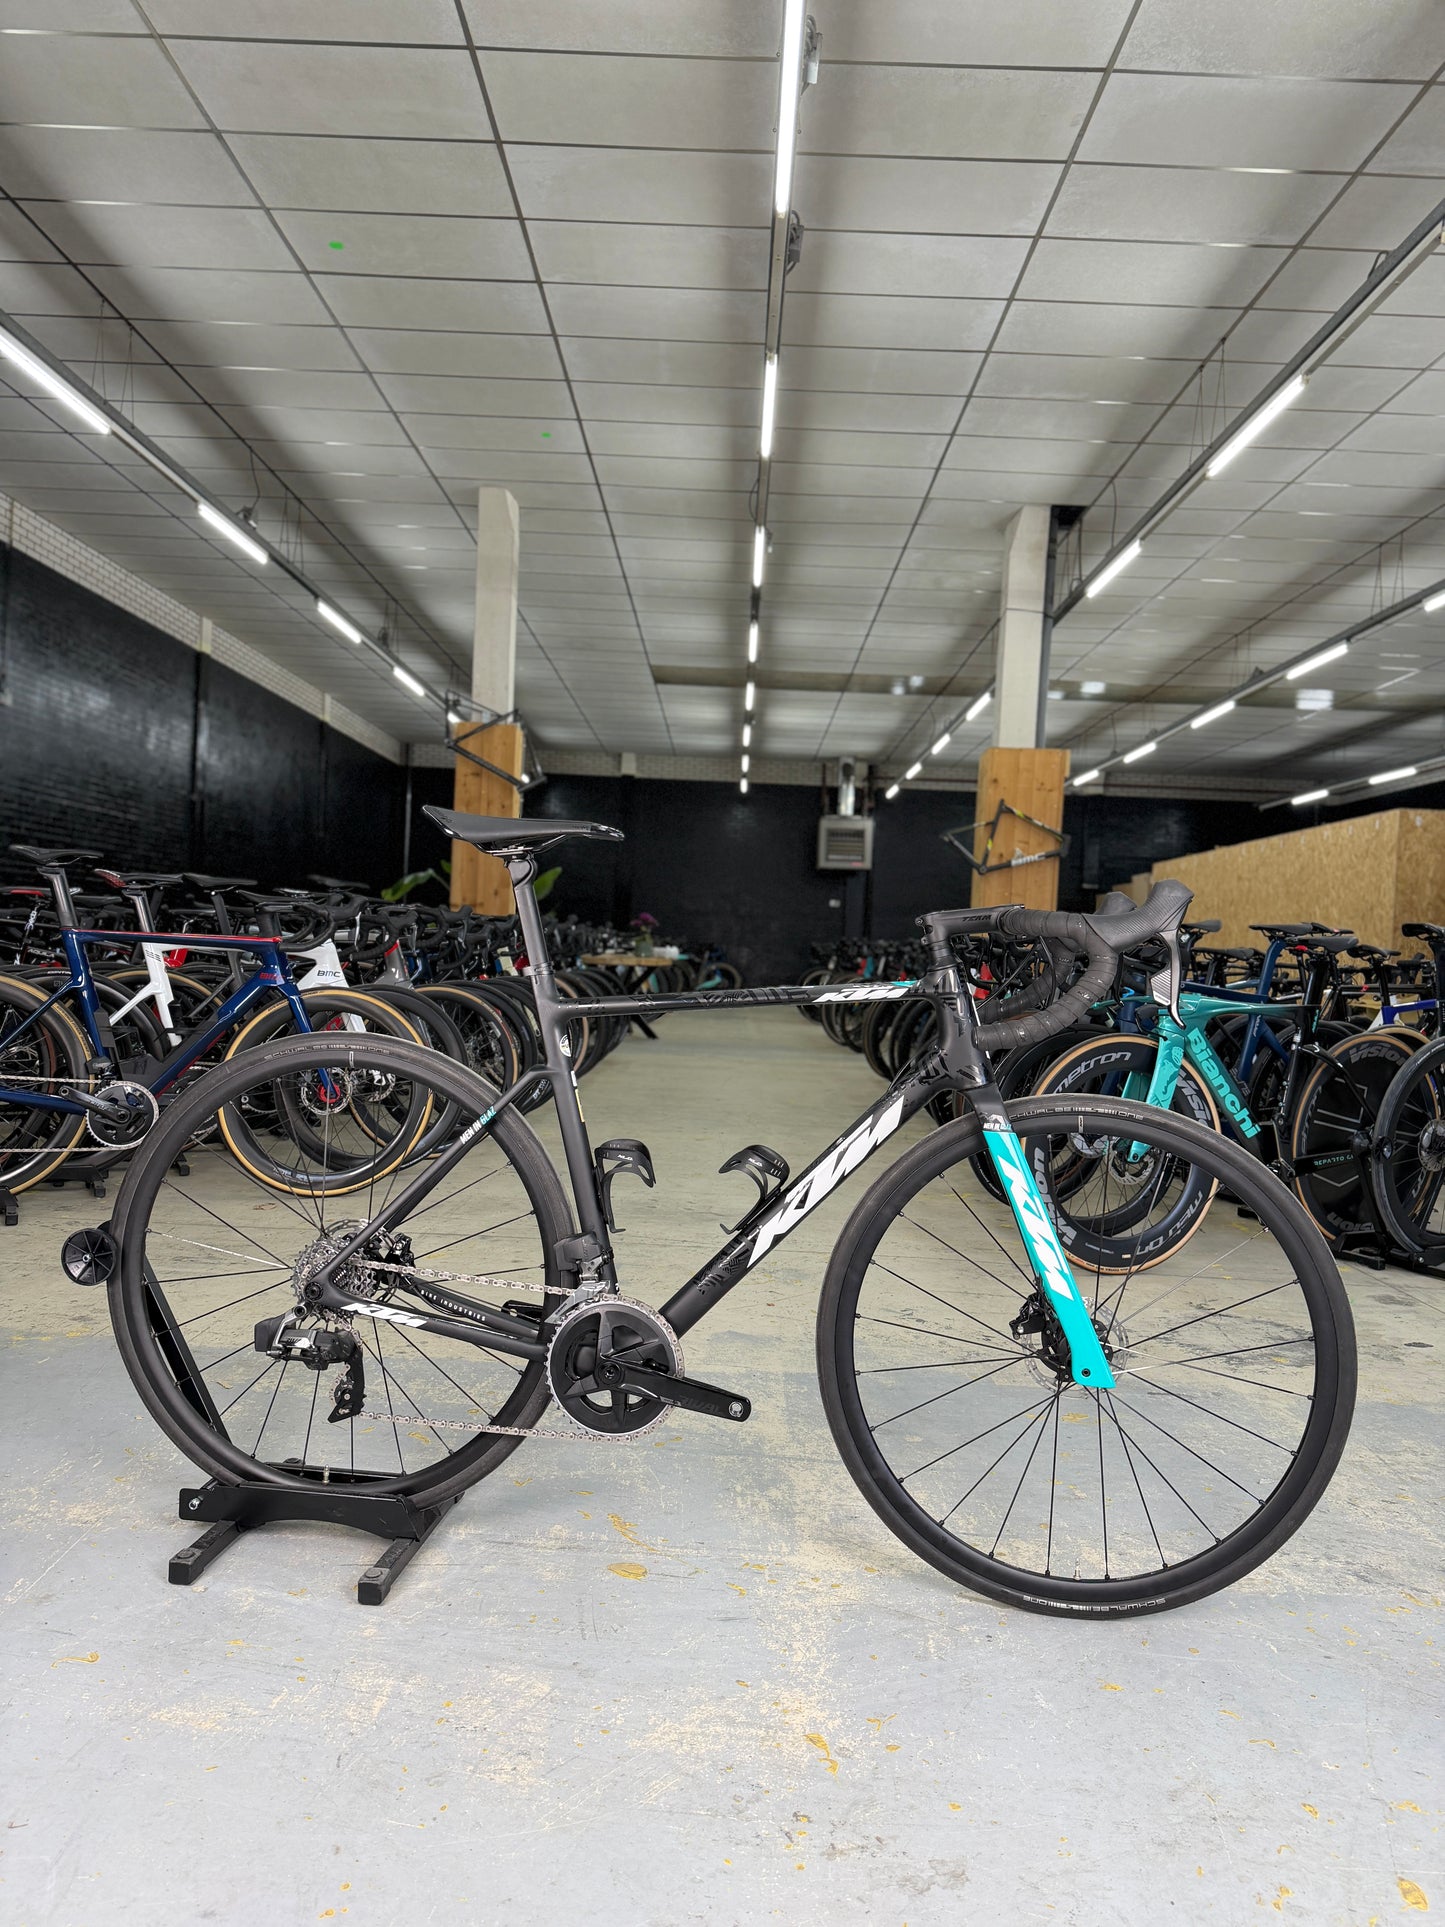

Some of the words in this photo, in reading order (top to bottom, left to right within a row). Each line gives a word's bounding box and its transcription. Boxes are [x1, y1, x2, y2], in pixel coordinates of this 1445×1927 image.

[962, 914, 992, 923] TEAM
[317, 970, 341, 978] BMC
[812, 987, 909, 1003] KTM
[1053, 1050, 1132, 1095] metron
[1187, 1027, 1261, 1139] Bianchi
[1009, 1106, 1073, 1121] CHWALBE
[1117, 1111, 1144, 1121] ONE
[460, 1127, 475, 1144] MEN
[472, 1119, 482, 1132] IN
[747, 1094, 905, 1268] KTM
[997, 1155, 1075, 1301] KTM
[340, 1302, 429, 1328] KTM
[420, 1289, 438, 1301] BIKE
[440, 1299, 487, 1322] INDUSTRIES
[1092, 1598, 1167, 1612] SCHWALBE
